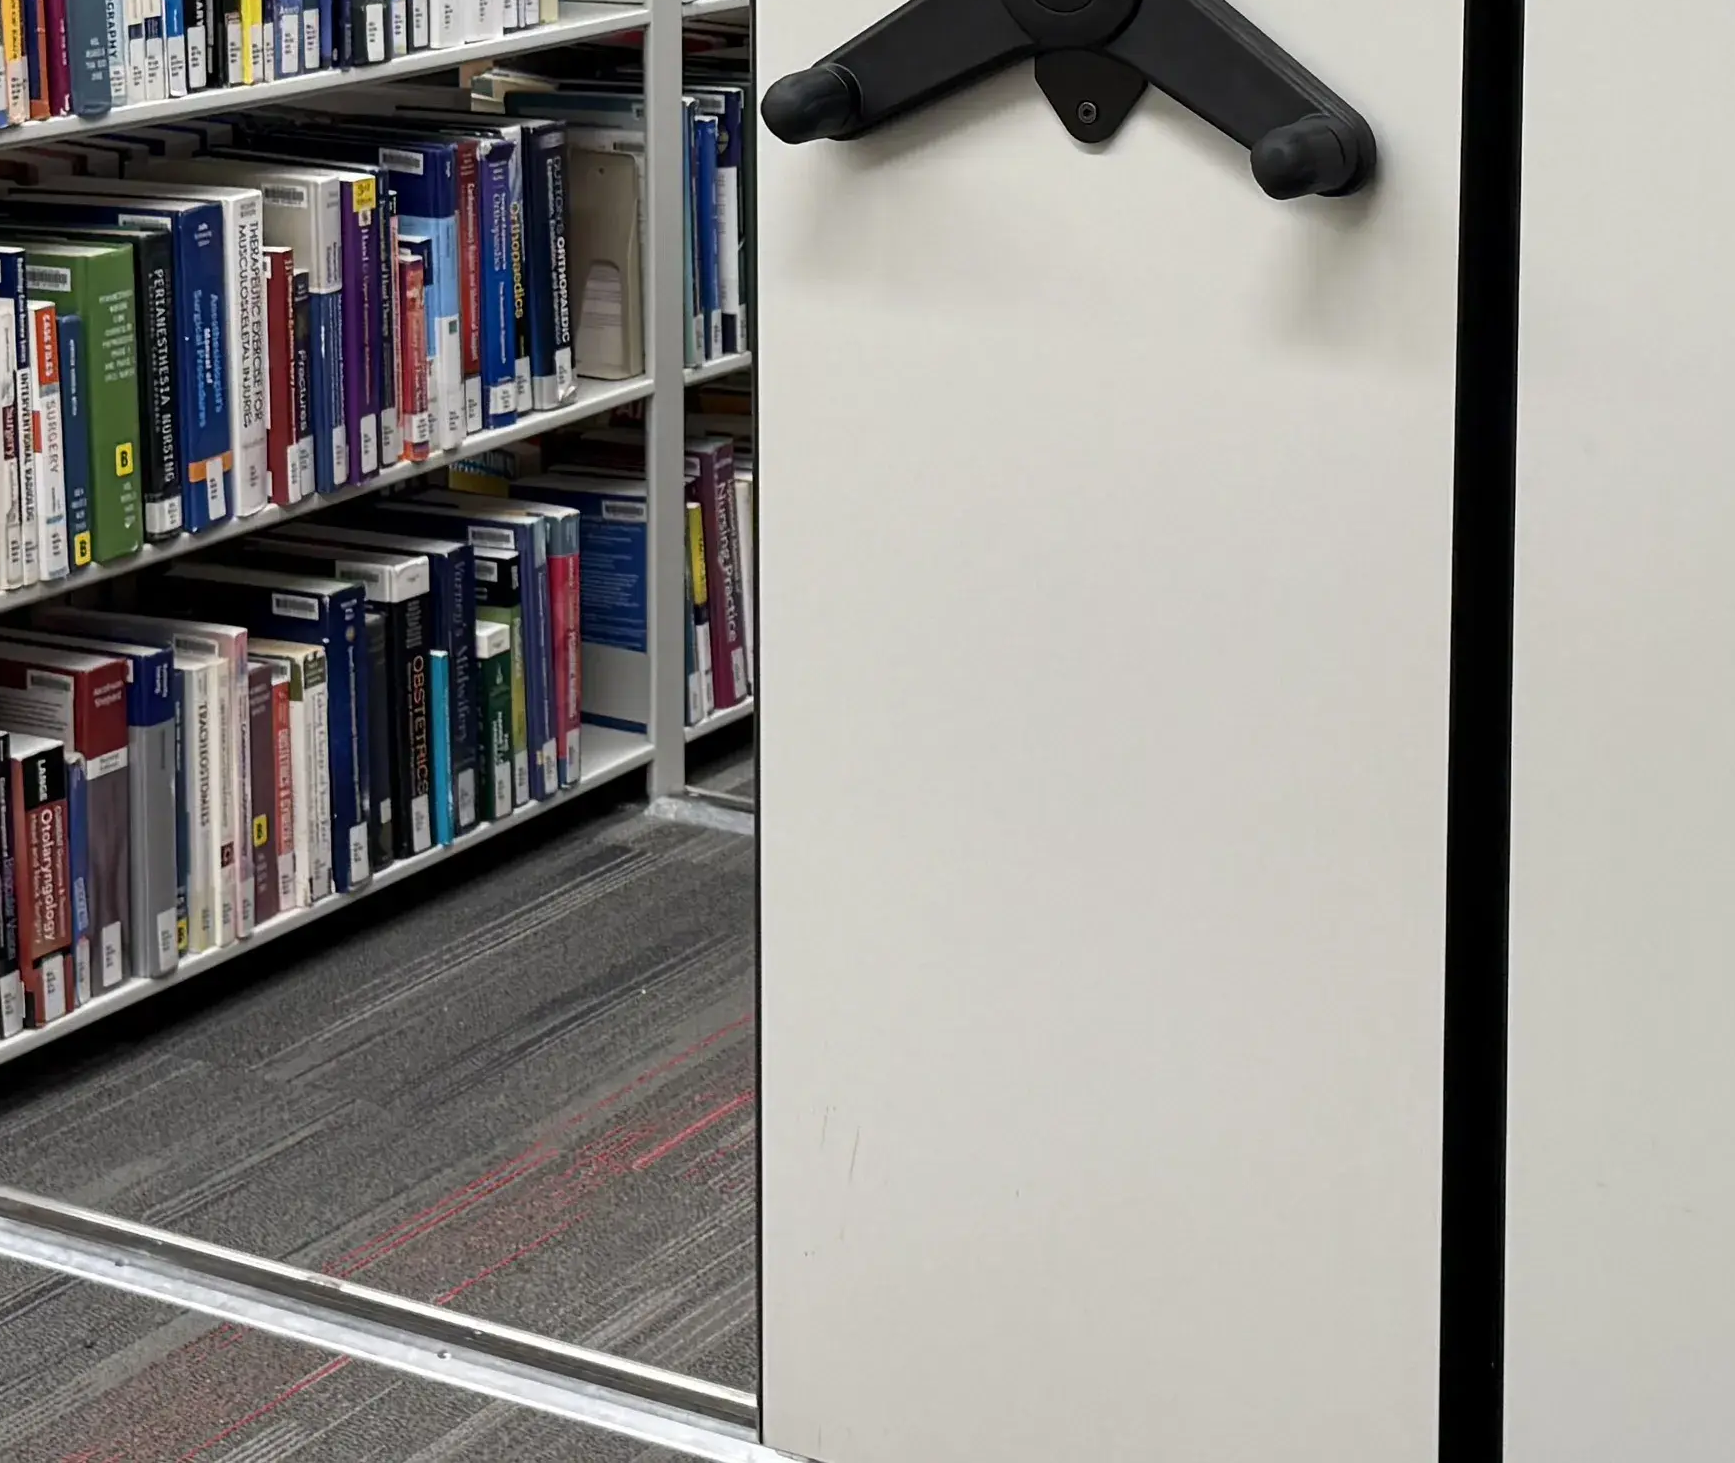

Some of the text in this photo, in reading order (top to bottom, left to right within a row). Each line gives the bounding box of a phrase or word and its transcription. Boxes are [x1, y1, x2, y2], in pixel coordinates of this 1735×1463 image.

[250, 222, 263, 422] THERAPEUTIC EXERCISE FOR
[509, 201, 525, 319] Orthopaedics
[557, 237, 570, 343] ORTHOPAEDIC
[153, 269, 176, 483] PERIANESTHESIA NURSING
[193, 290, 207, 427] Surgical Procedures
[238, 224, 251, 427] MUSCULOSKELETAL INJURIES
[4, 407, 16, 457] Surgery
[20, 373, 33, 465] INTERVENTIONAL
[46, 401, 59, 474] SURGERY
[297, 350, 307, 431] Fractures
[715, 481, 739, 643] Nursing Practice
[453, 561, 468, 743] Varney's Midwifery
[37, 759, 48, 801] LANGE
[197, 701, 211, 827] TRACHEOSTOMIES
[412, 655, 429, 796] OBSTETRICS
[40, 808, 56, 941] Otolaryngology
